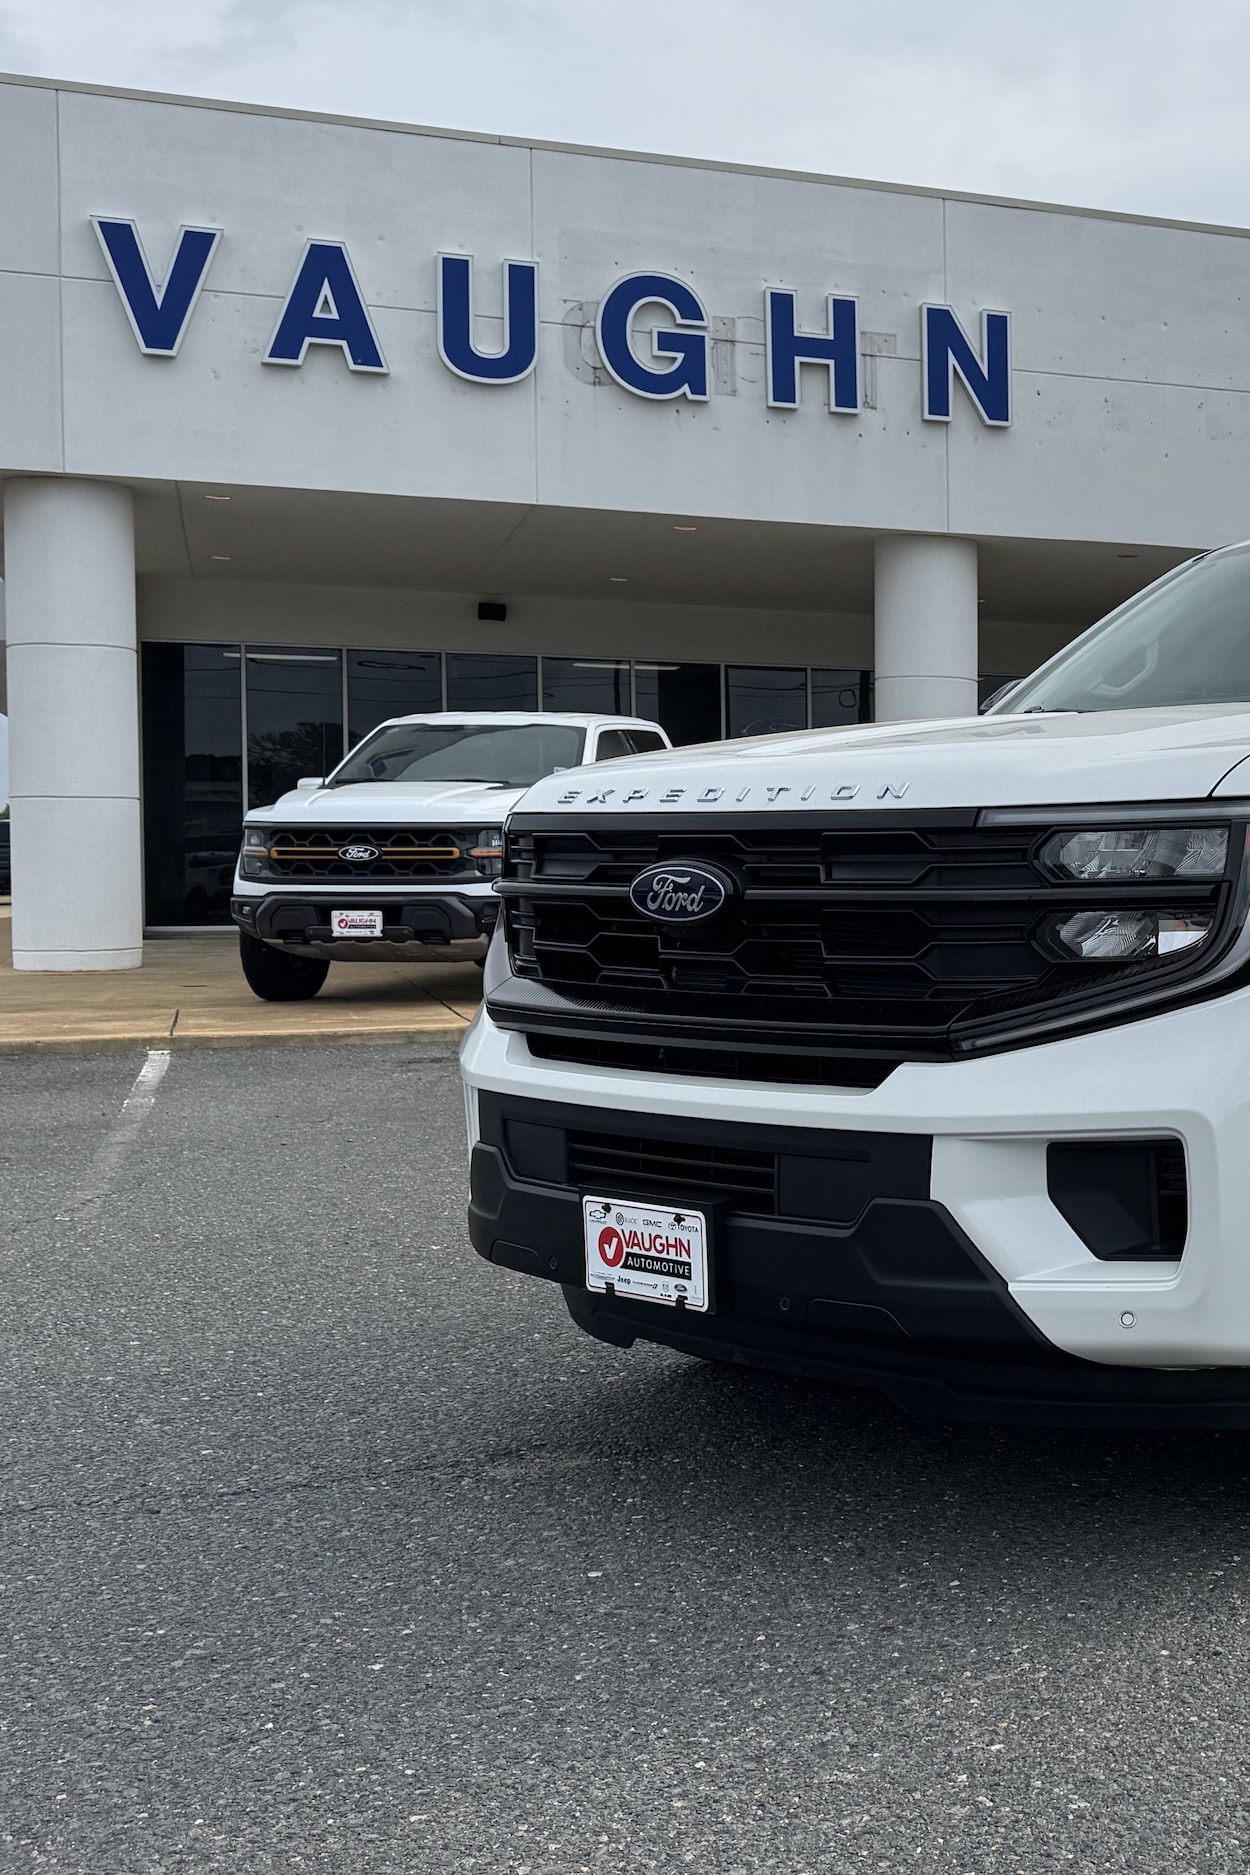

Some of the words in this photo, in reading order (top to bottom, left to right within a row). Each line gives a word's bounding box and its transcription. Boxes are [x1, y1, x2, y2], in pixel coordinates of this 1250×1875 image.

[89, 214, 1012, 427] VAUGHN
[557, 782, 911, 804] EXPEDITION
[346, 847, 370, 858] Ford
[647, 873, 704, 913] Ford
[643, 1219, 662, 1228] GMC
[621, 1229, 692, 1259] VAUGHN
[627, 1257, 690, 1276] AUTOMOTIVE
